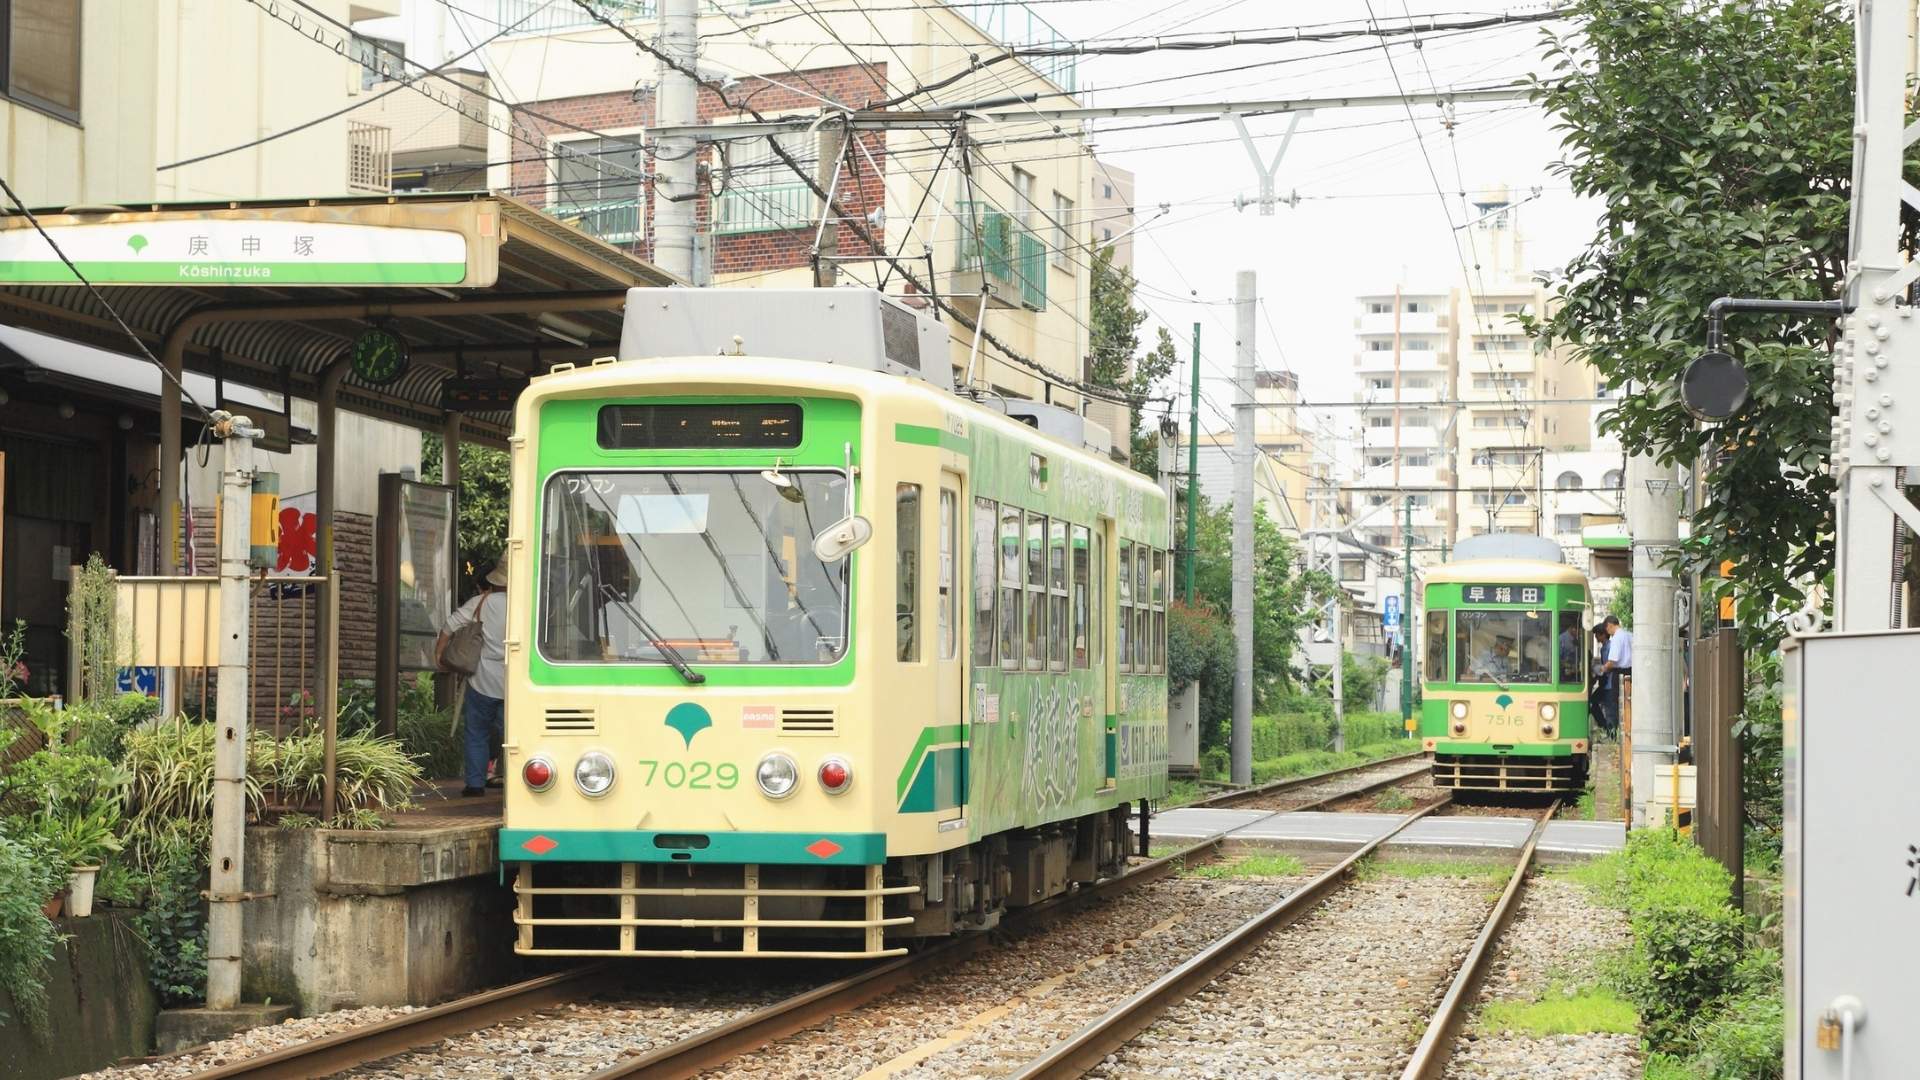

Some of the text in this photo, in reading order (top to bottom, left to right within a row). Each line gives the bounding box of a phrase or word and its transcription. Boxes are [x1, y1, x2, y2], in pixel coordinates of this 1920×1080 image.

[187, 234, 315, 257] 庚申塚
[567, 478, 616, 495] ワンマン
[1468, 586, 1538, 603] 早稲田
[1484, 714, 1525, 727] 7516
[638, 760, 739, 790] 7029
